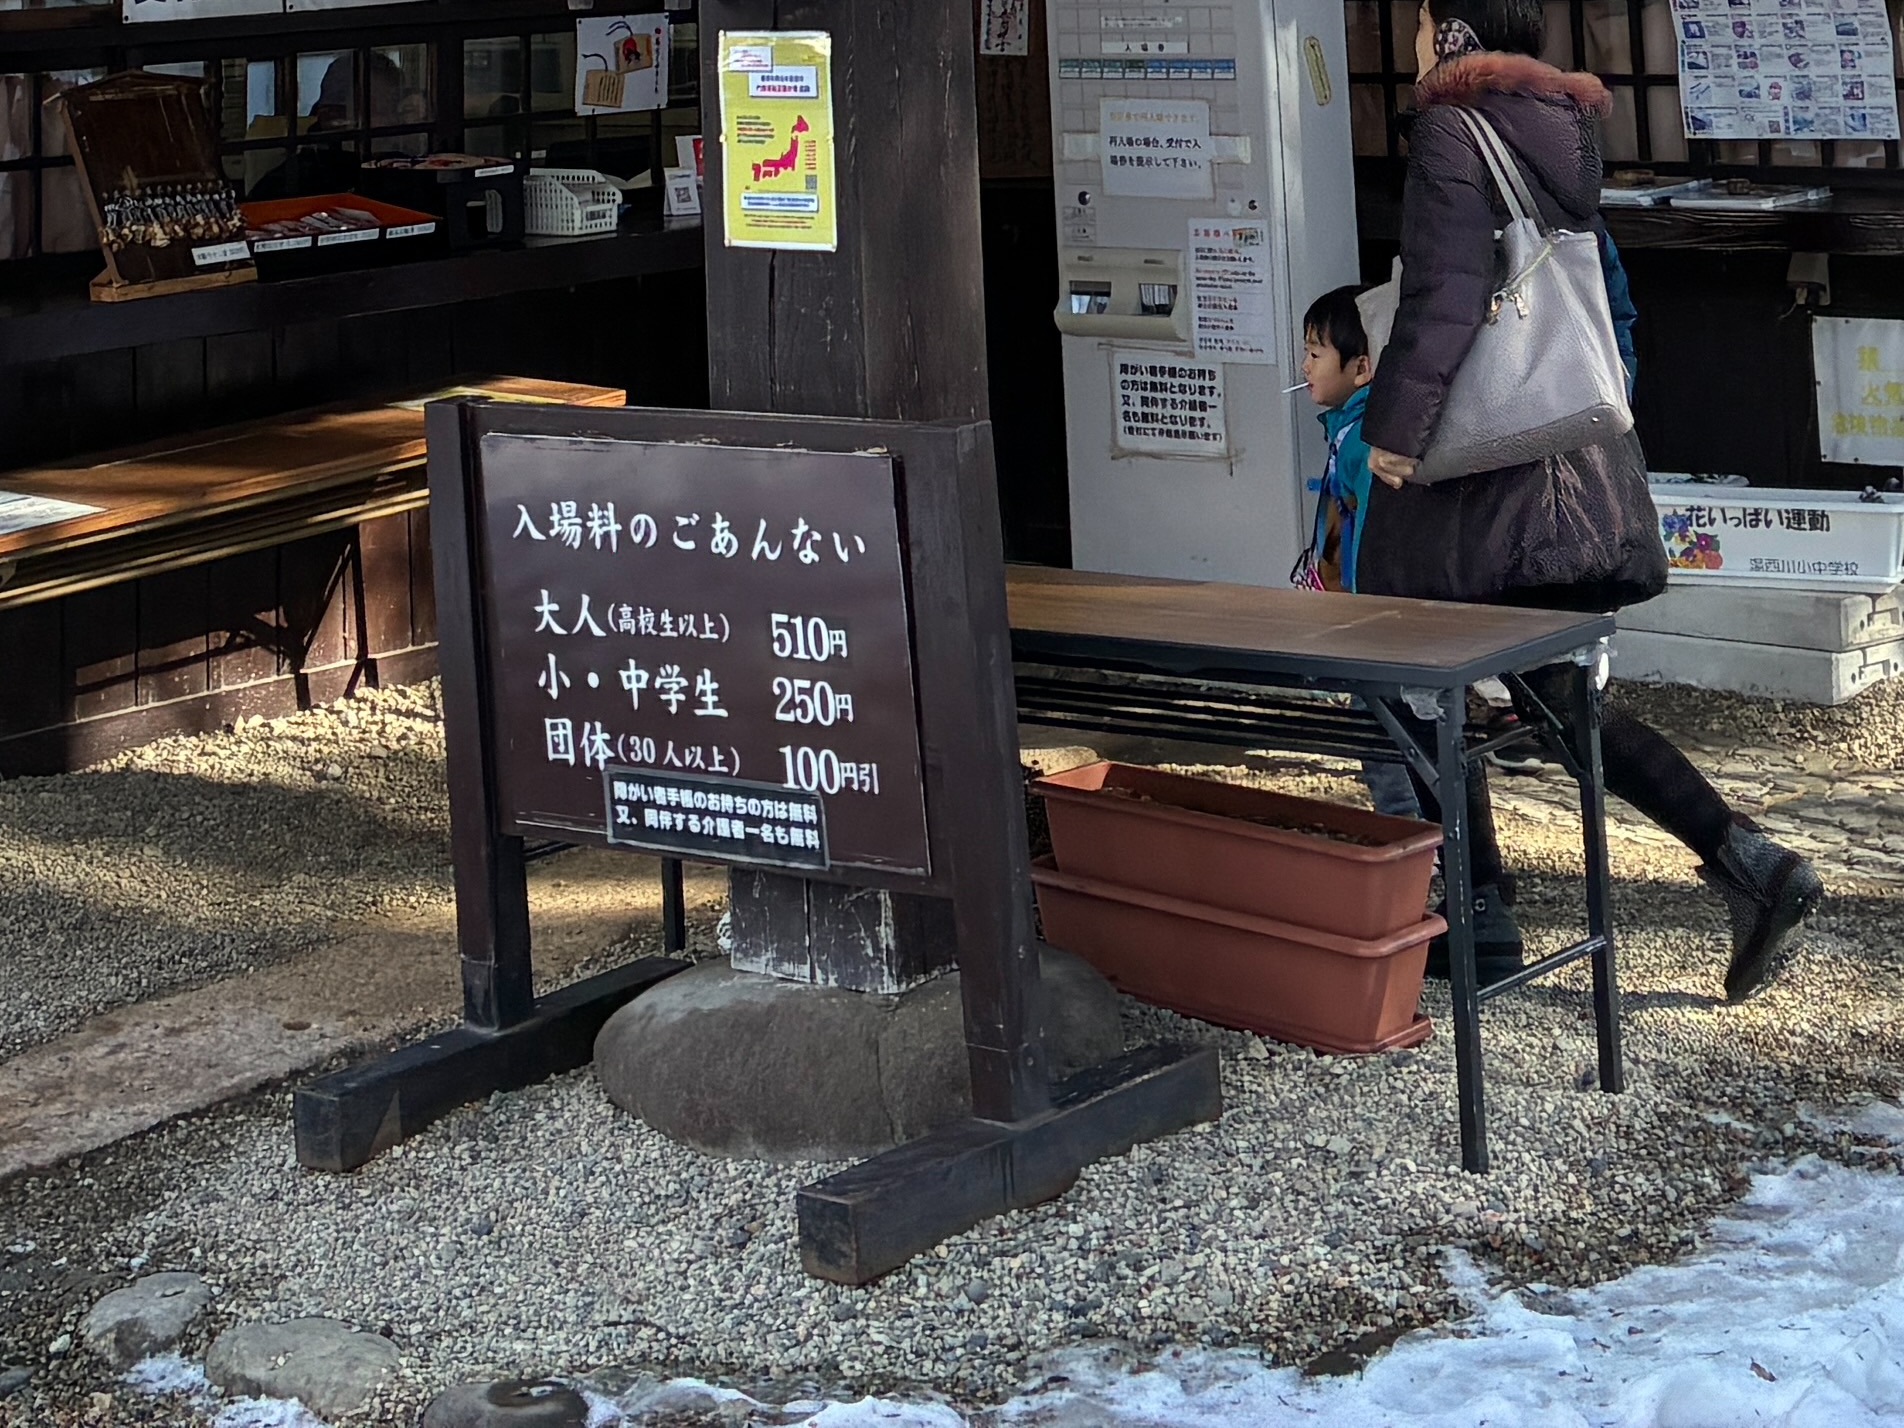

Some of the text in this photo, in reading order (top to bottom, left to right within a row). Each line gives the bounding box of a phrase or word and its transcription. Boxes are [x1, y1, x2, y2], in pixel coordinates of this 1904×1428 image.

[512, 501, 865, 564] 入場料のごあんない
[1686, 505, 1831, 533] 花いっぱい運動
[1749, 557, 1859, 576] 湯西川小中学校
[771, 612, 847, 659] 510円
[538, 652, 853, 726] 小・中学生 250円
[778, 746, 879, 795] 100円引
[613, 780, 818, 825] 障がい者手帳のお持ちの方は無料
[615, 804, 820, 850] 又、同伴する介護者一名も無料
